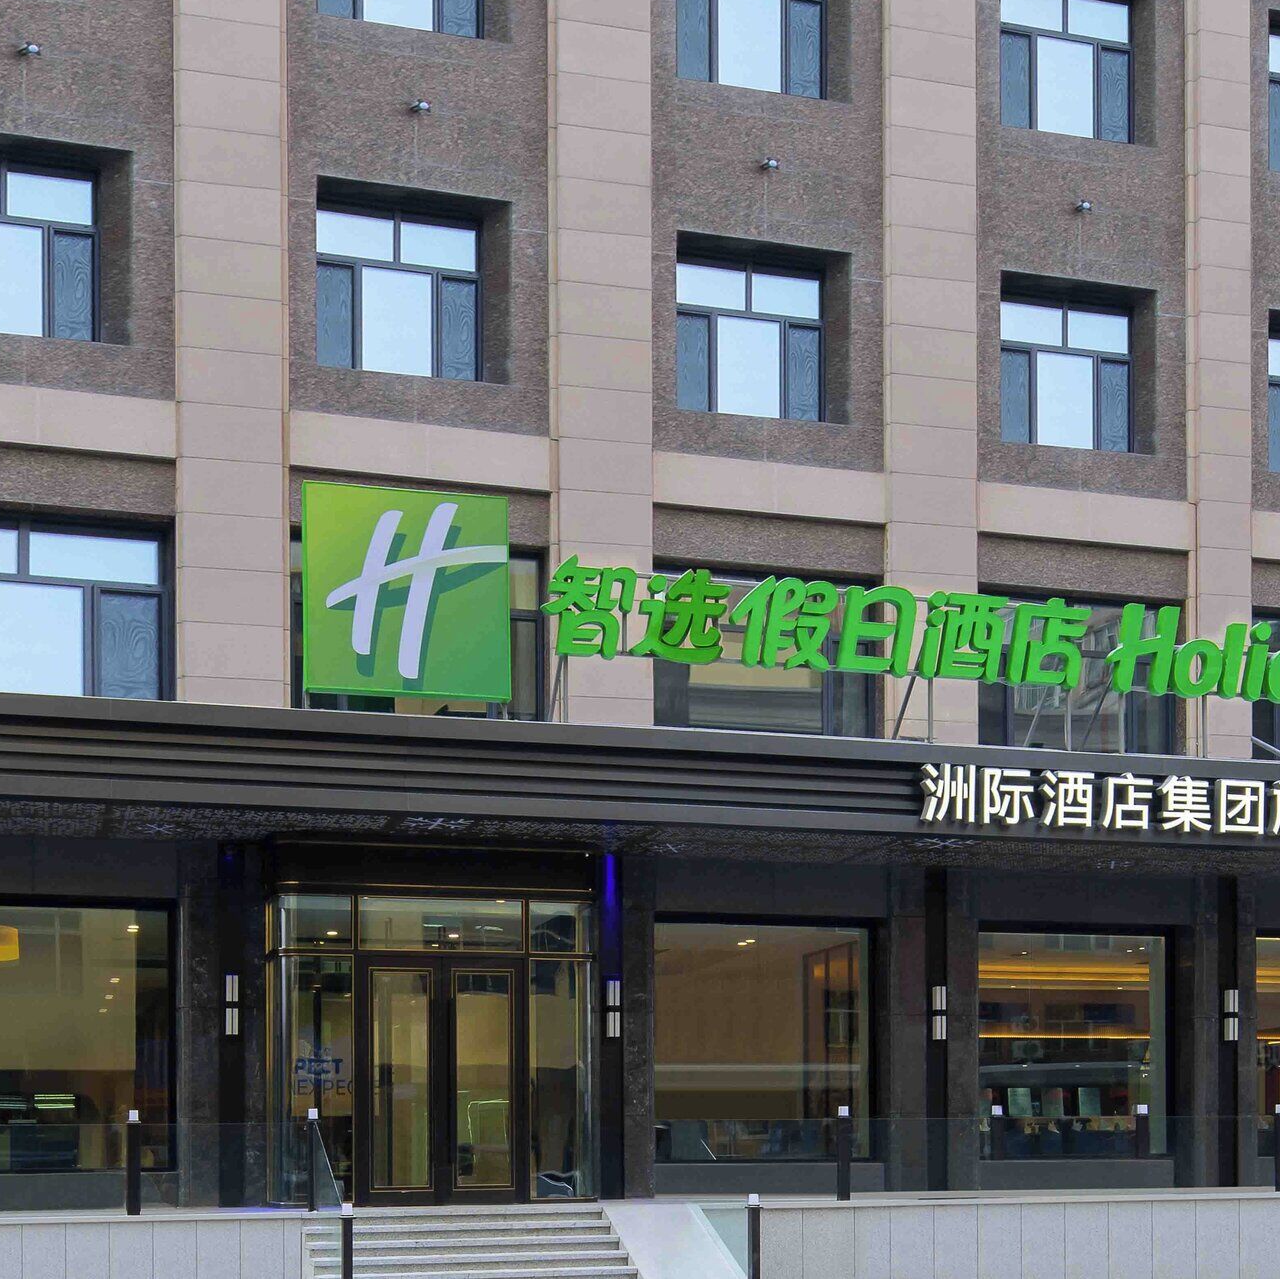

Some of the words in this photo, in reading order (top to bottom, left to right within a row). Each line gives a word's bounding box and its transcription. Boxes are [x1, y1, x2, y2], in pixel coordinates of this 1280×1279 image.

[541, 554, 1091, 691] 智选假日酒店
